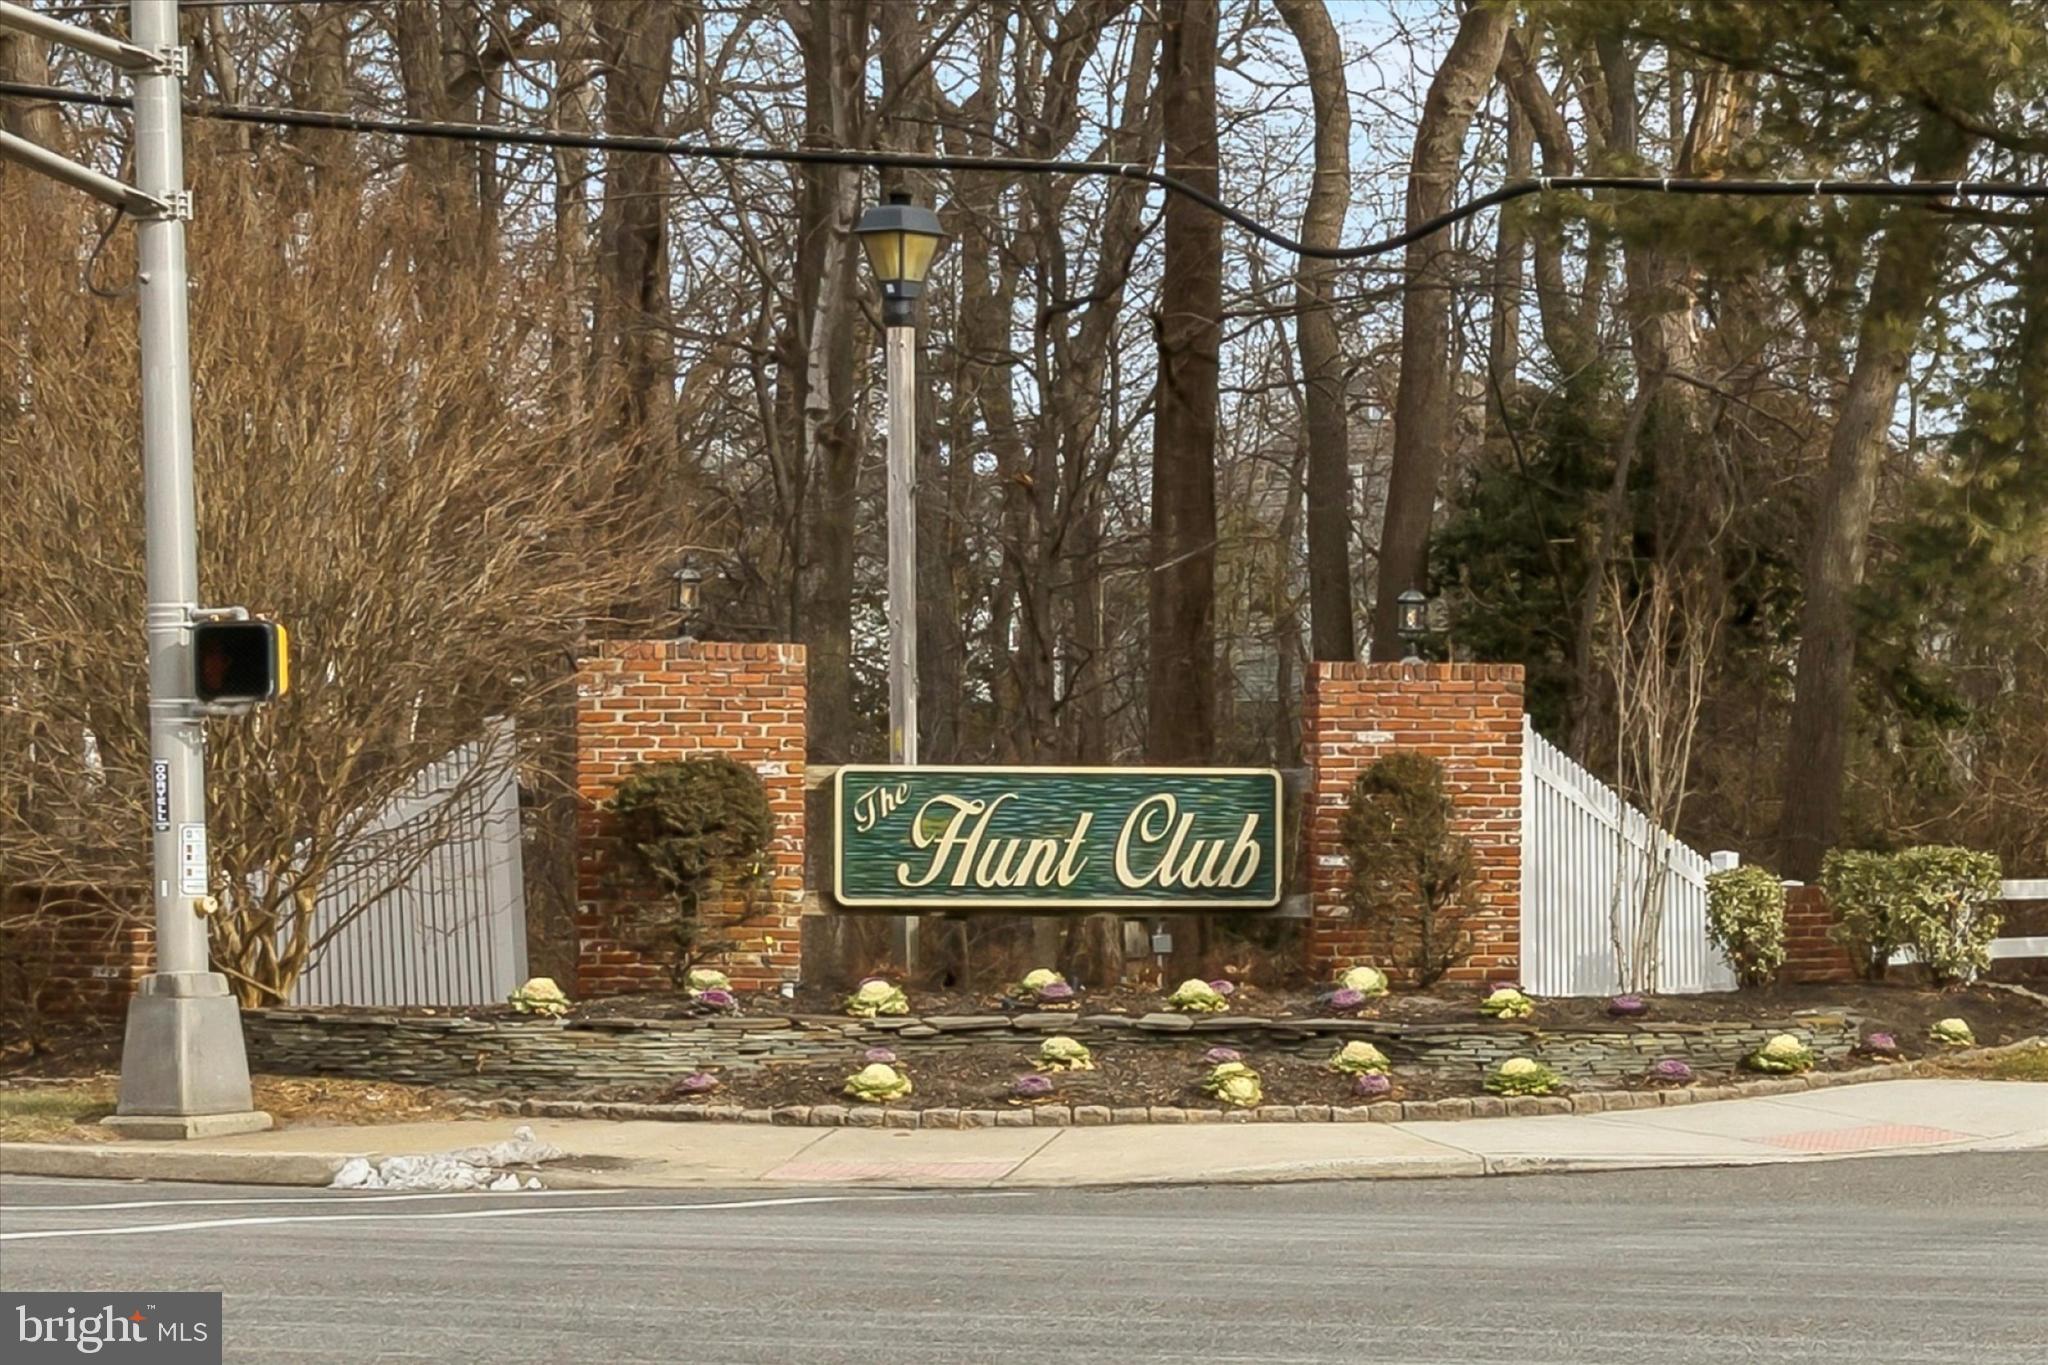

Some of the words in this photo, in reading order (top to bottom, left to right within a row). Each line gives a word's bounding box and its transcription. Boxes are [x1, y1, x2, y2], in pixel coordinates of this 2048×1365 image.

[853, 782, 911, 832] The
[896, 793, 1096, 887] Hunt
[1114, 792, 1261, 888] Club
